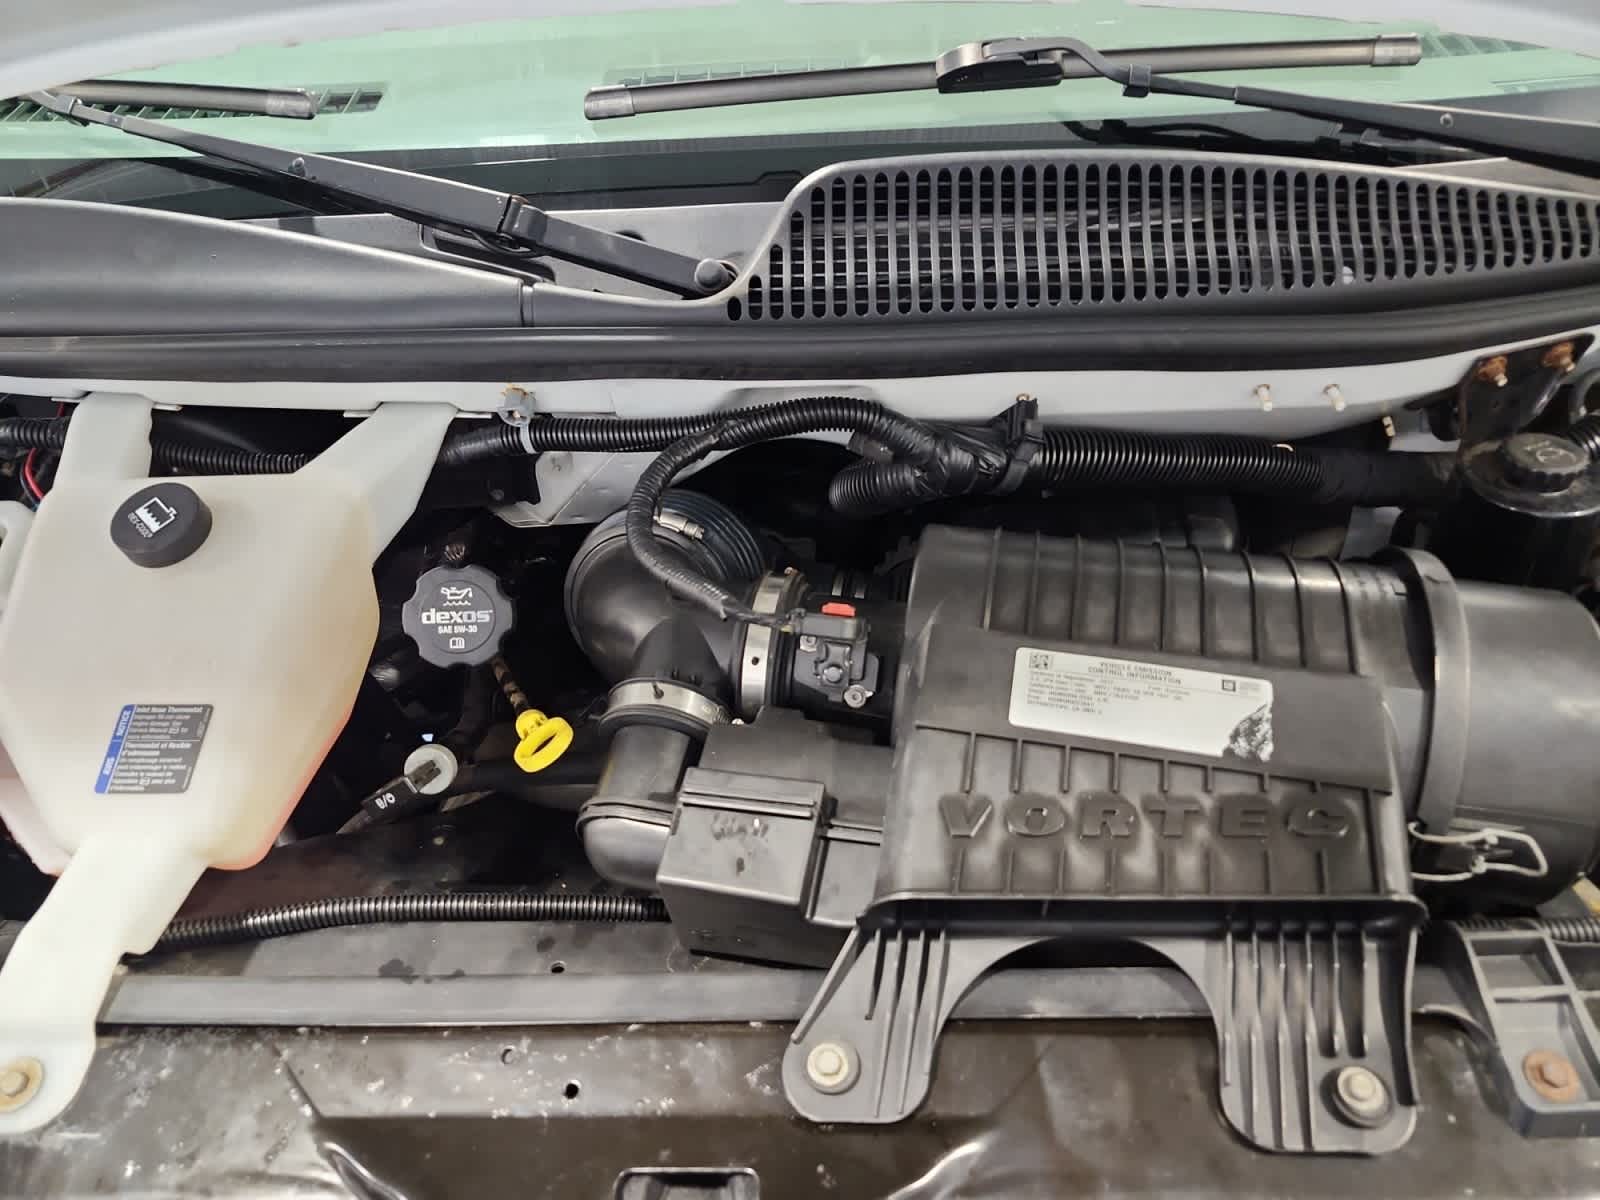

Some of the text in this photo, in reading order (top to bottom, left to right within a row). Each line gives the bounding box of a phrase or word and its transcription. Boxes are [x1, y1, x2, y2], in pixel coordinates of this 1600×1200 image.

[421, 608, 491, 624] dexos
[438, 626, 453, 634] SAE
[938, 796, 1351, 839] VORTEC
